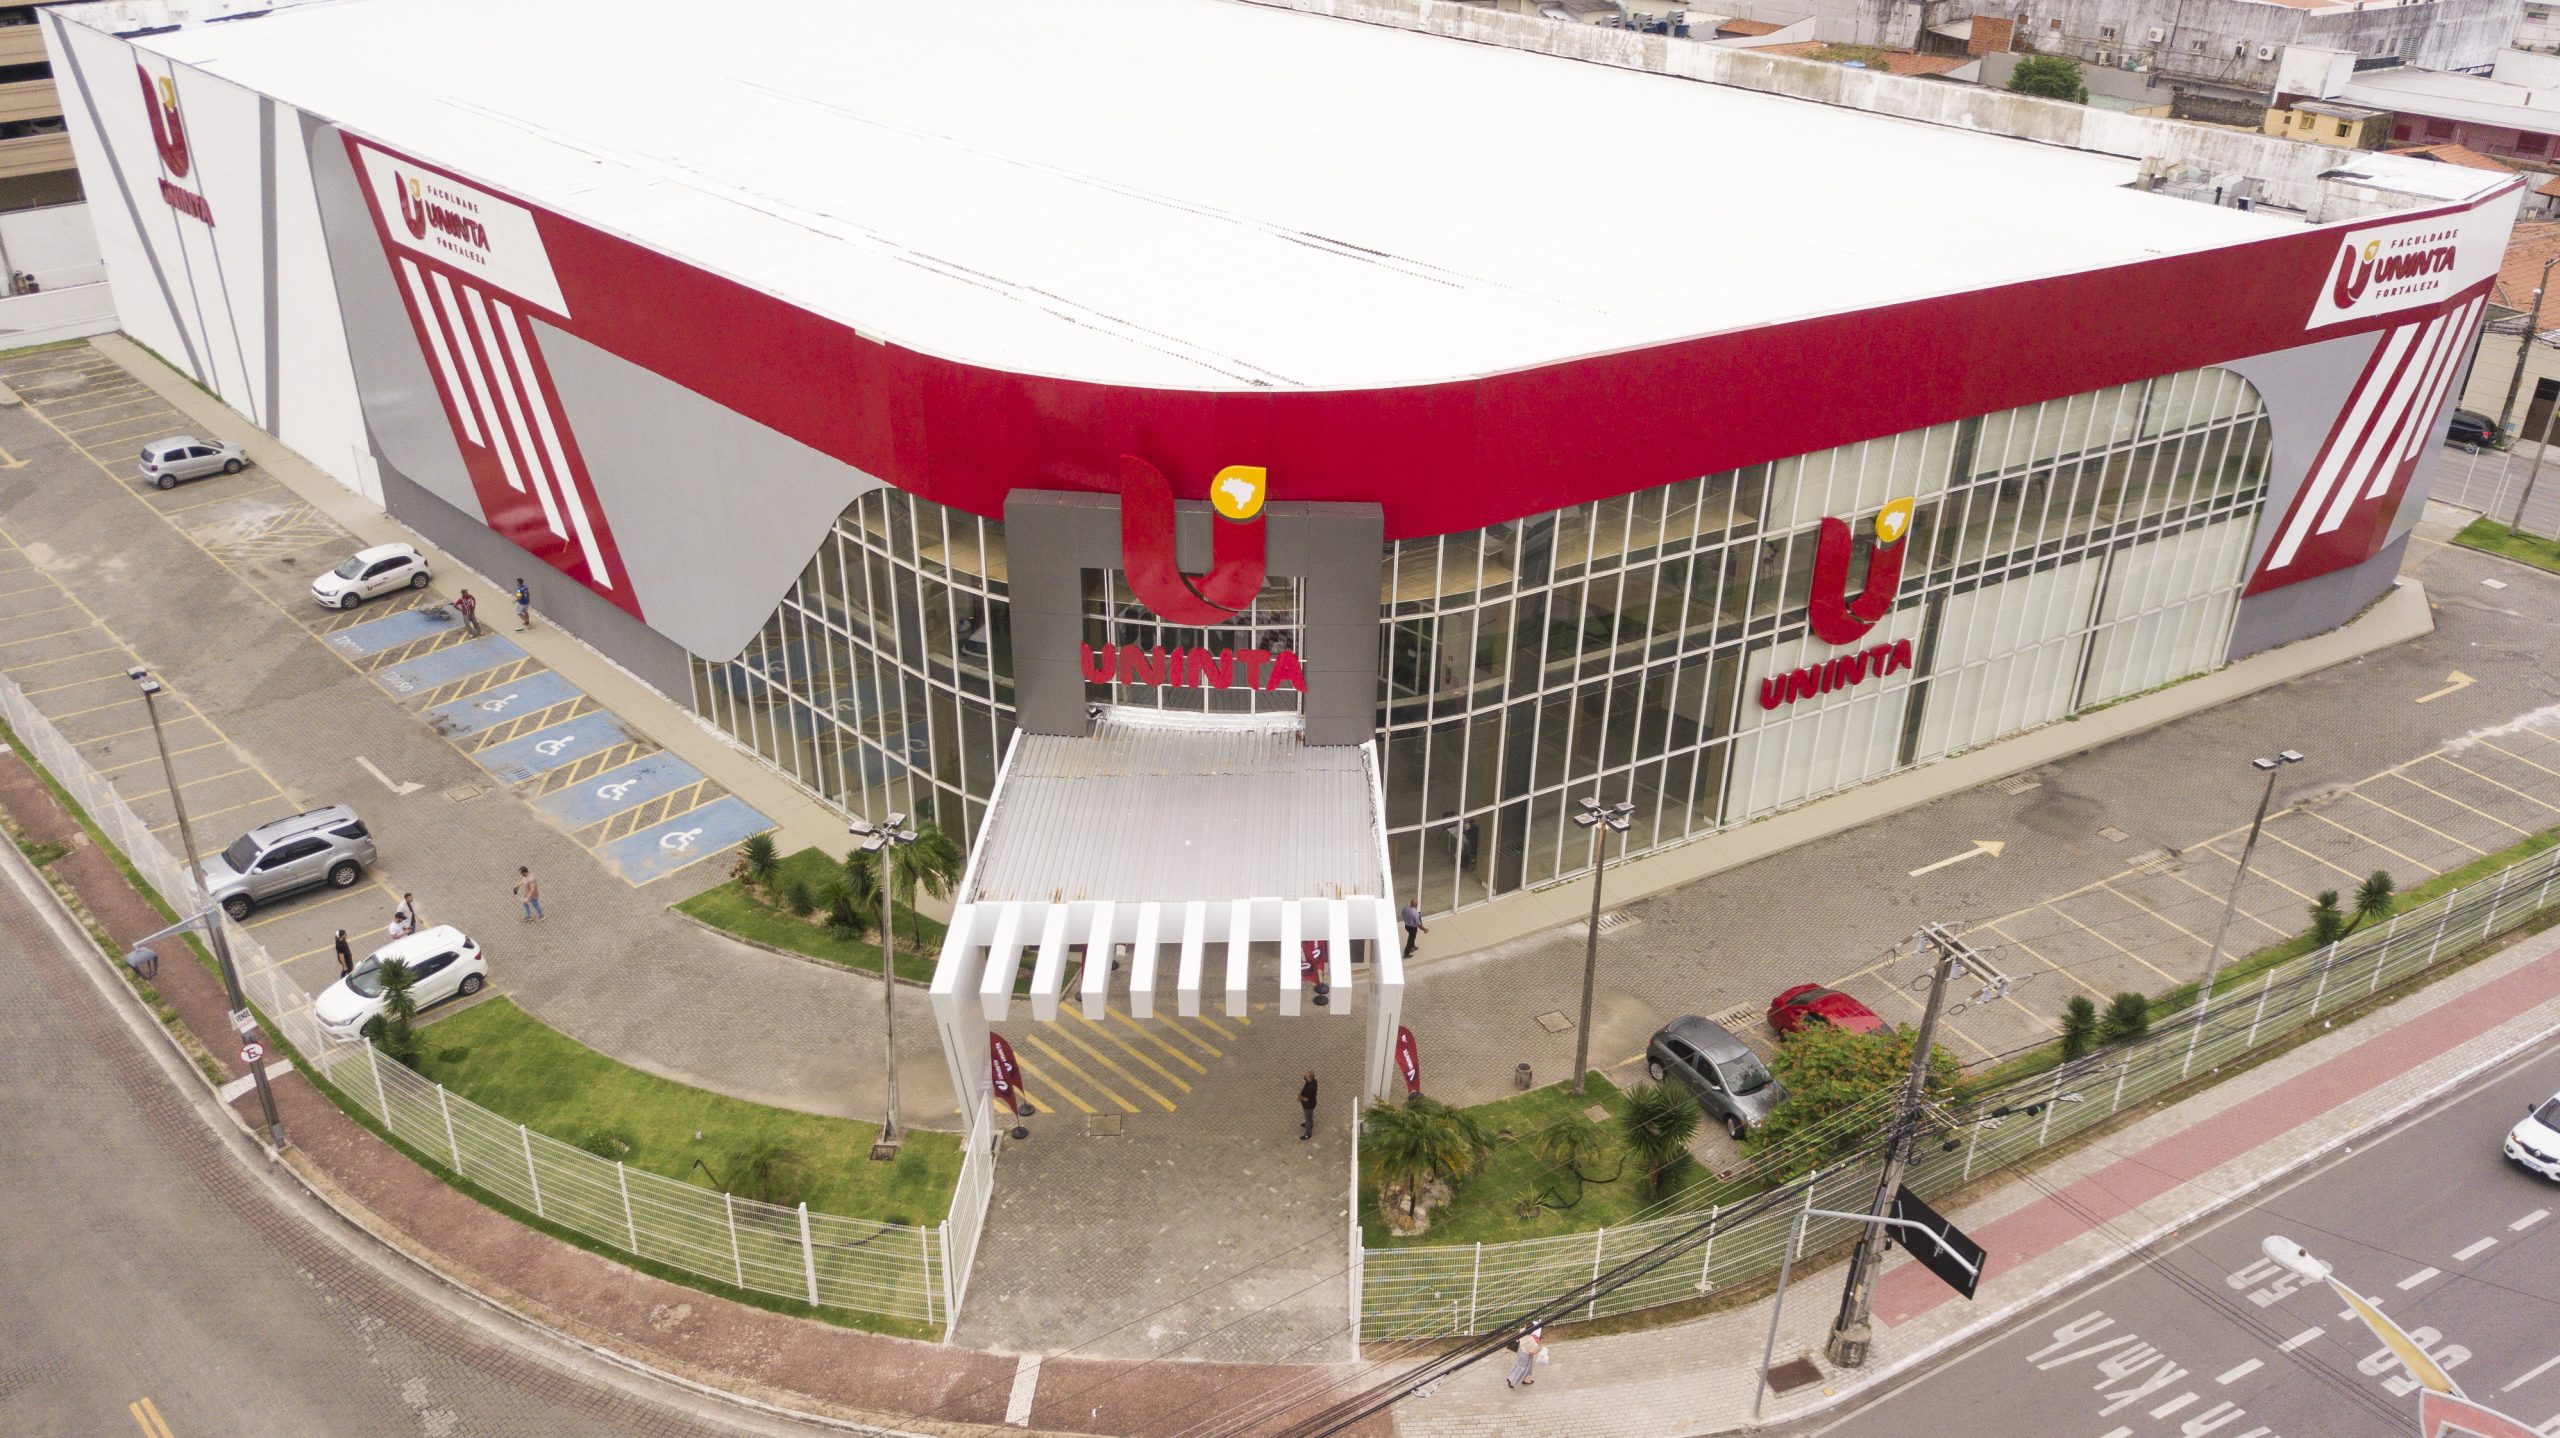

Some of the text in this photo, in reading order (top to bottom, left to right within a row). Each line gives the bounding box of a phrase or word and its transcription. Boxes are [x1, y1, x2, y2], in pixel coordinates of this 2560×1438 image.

[427, 185, 479, 213] FACULDADE
[425, 200, 491, 252] UNINTA
[2390, 229, 2459, 249] FACULDADE
[437, 236, 486, 265] FORTALEZA
[2374, 245, 2456, 283] UNINTA
[2375, 280, 2439, 299] FORTALEZA
[1080, 640, 1308, 693] UNINTA
[1759, 638, 1912, 710] UNINTA
